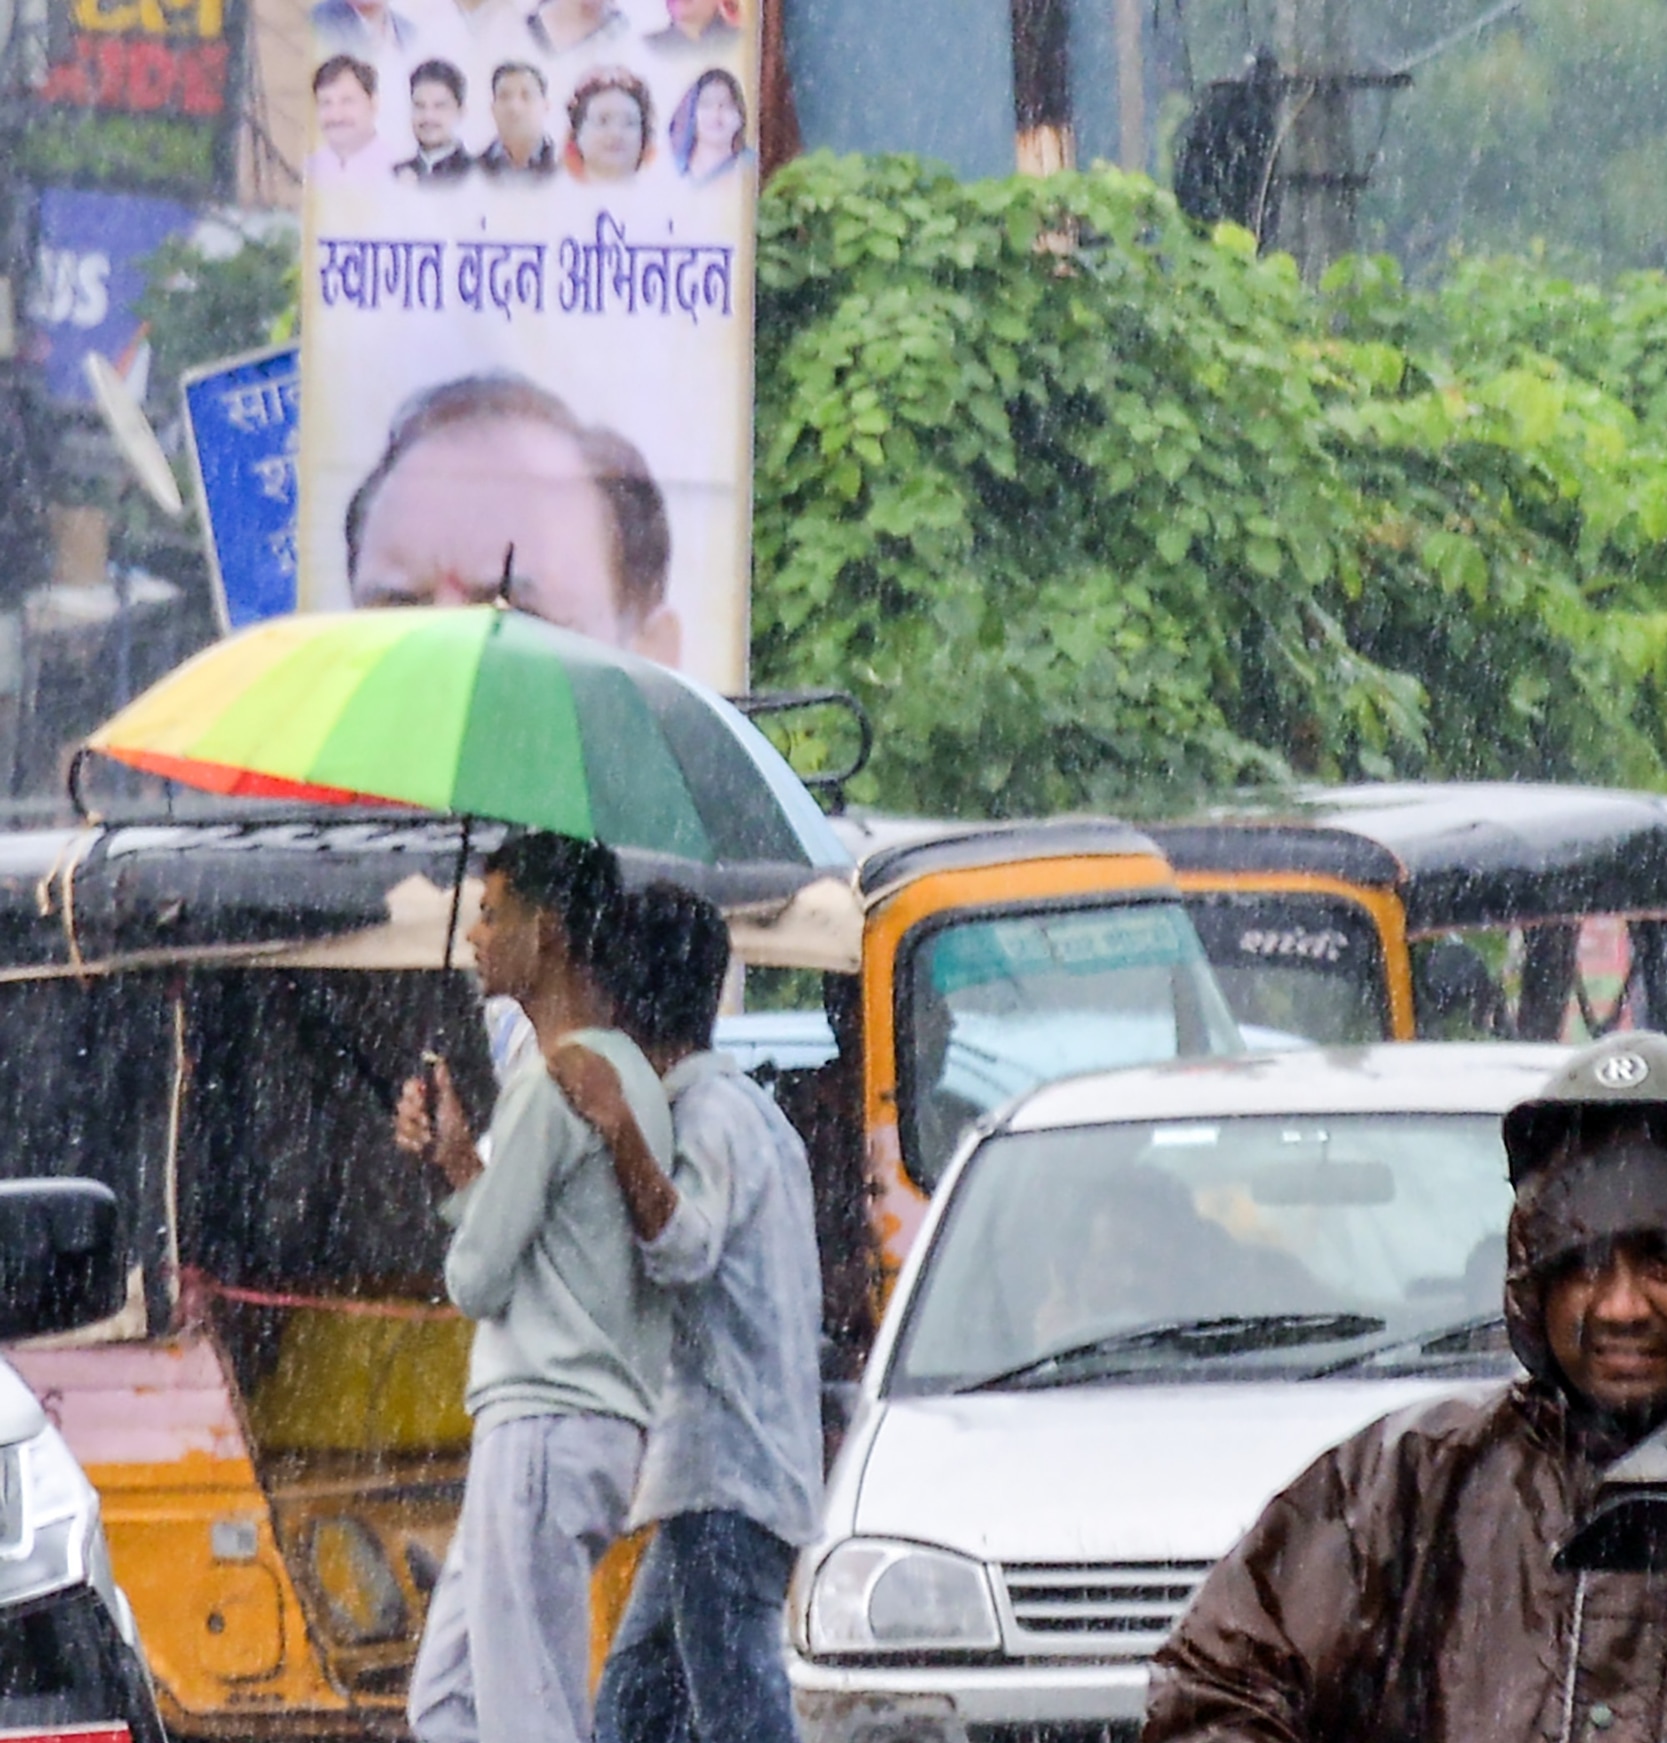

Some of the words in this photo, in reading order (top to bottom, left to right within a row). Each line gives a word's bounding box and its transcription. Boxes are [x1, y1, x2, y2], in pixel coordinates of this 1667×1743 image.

[318, 239, 445, 310] स्वागत
[457, 216, 547, 321] वंदन
[559, 208, 734, 324] अभिनंदन
